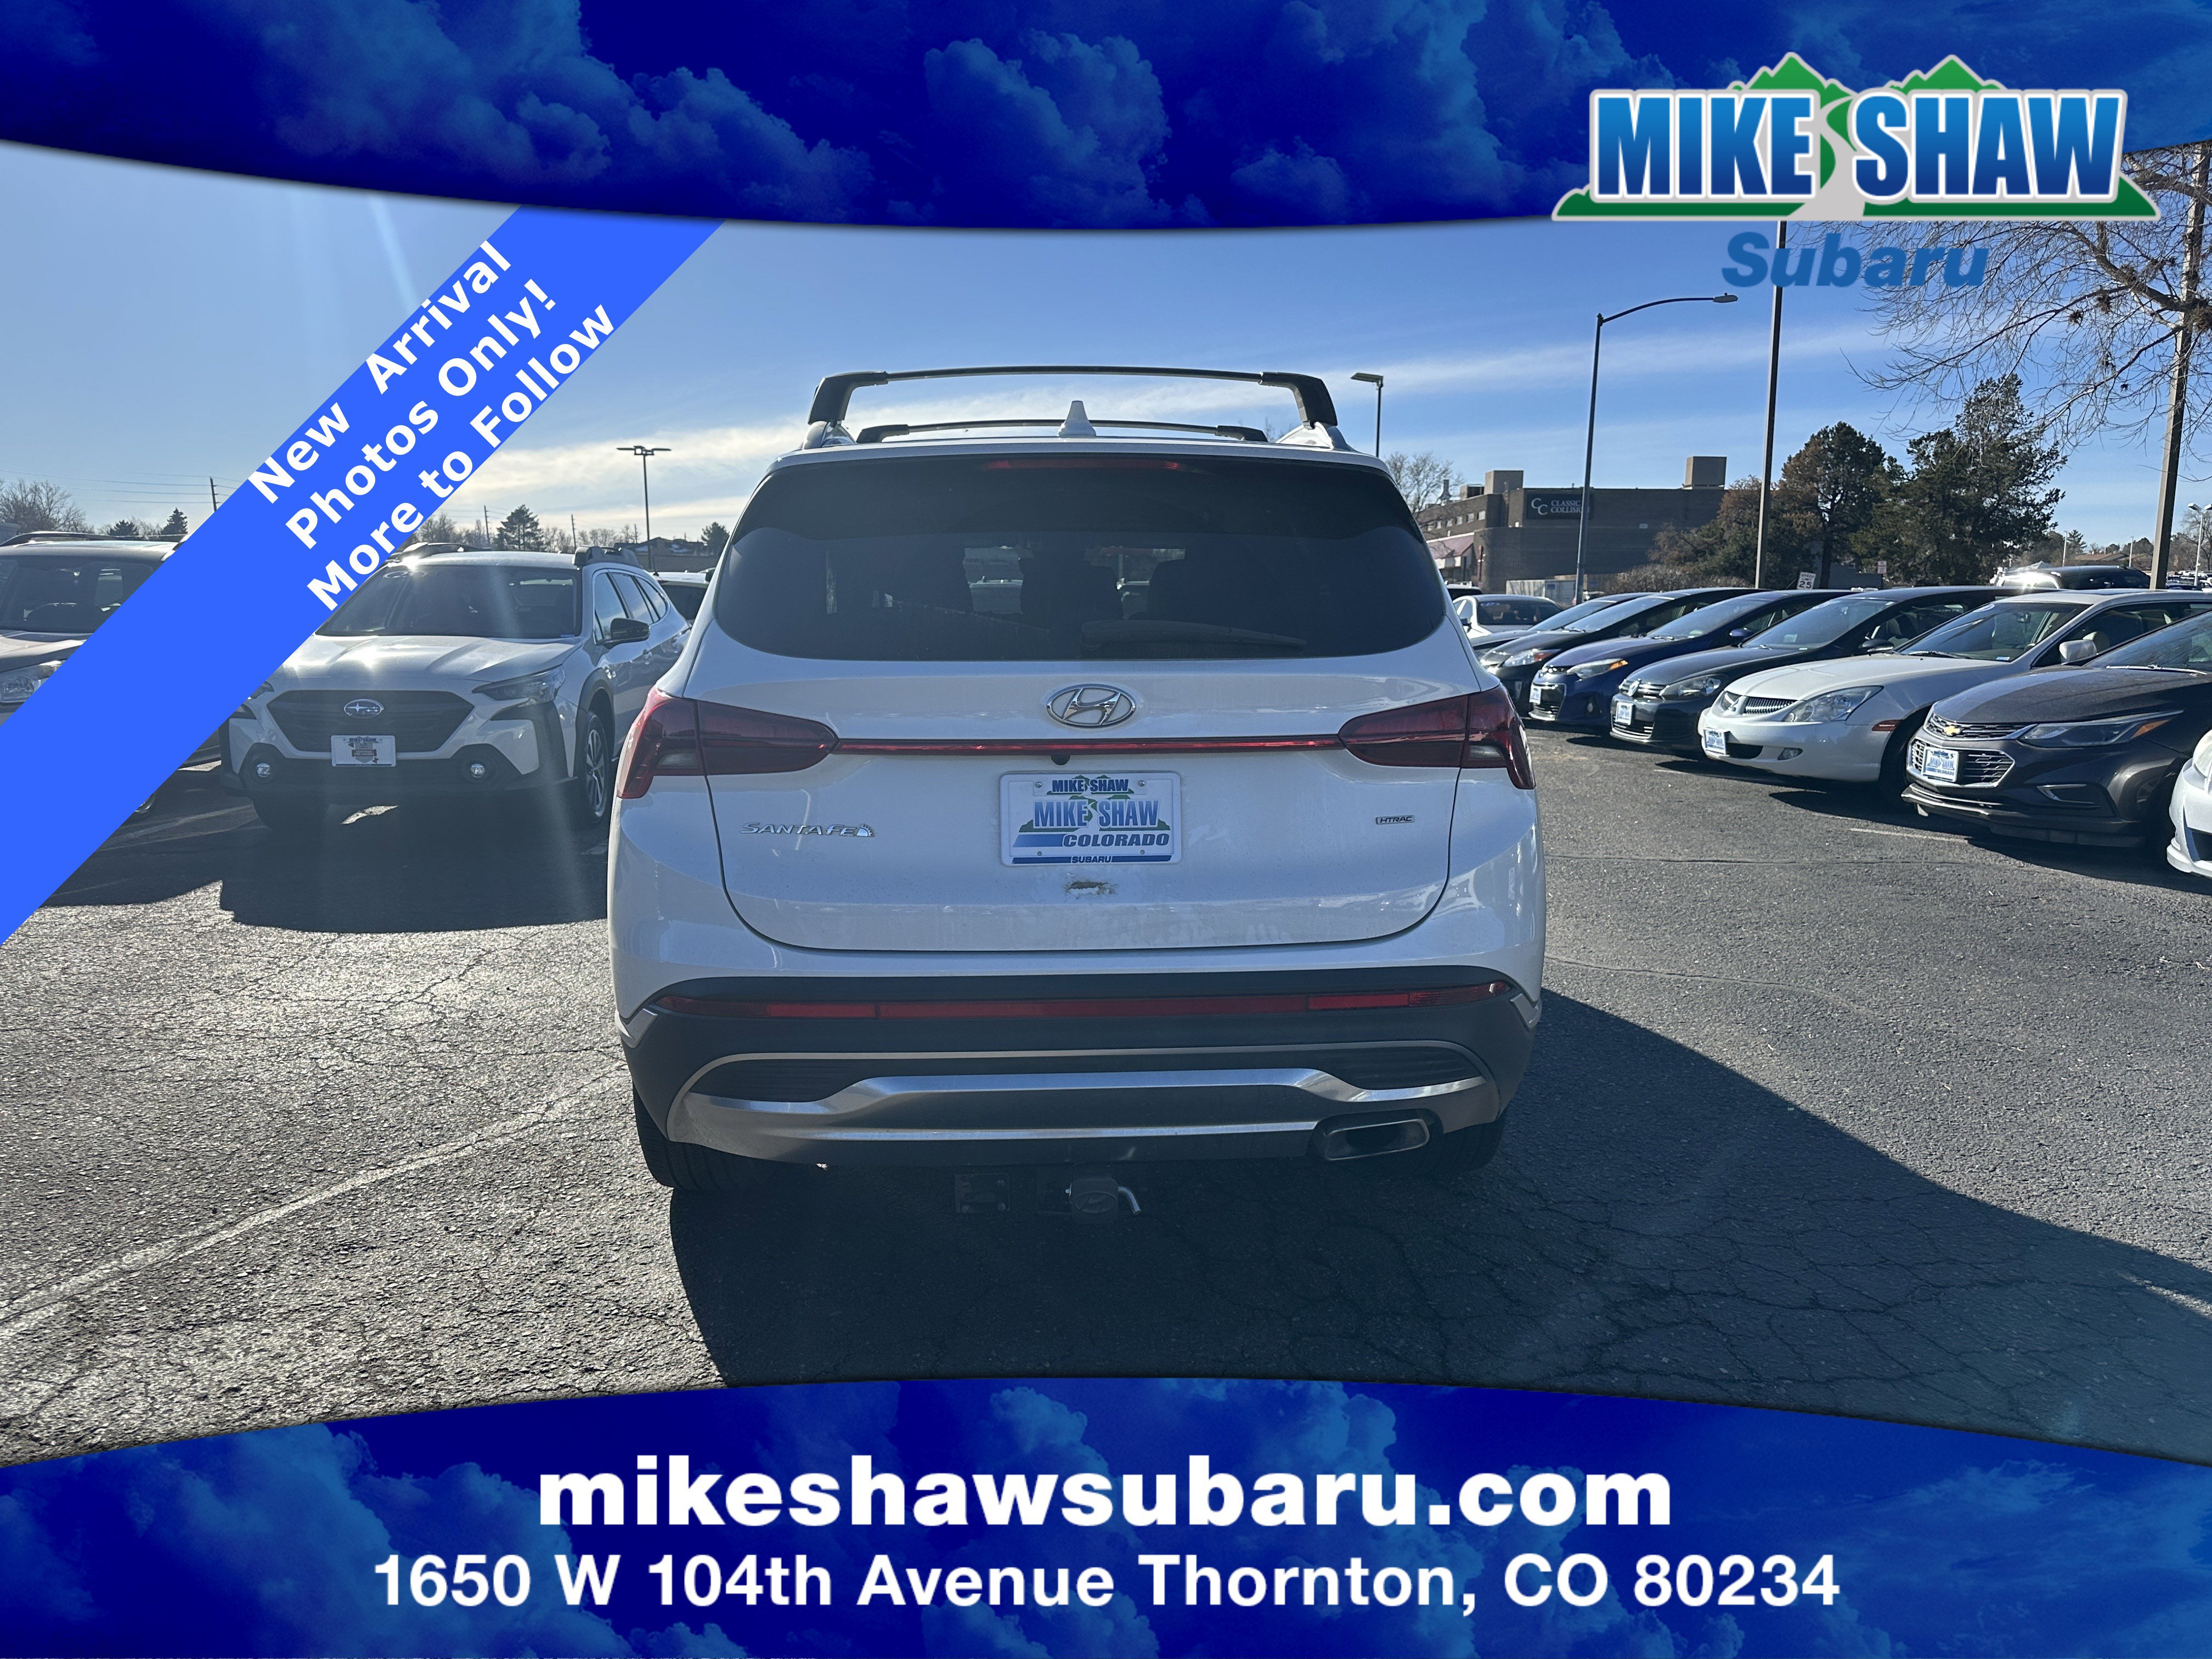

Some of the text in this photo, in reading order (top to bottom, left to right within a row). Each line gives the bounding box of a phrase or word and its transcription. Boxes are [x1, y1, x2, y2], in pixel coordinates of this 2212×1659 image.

[1052, 779, 1129, 792] MIKE SHAW
[1034, 800, 1159, 827] MIKE SHAW
[1063, 833, 1170, 847] COLORADO
